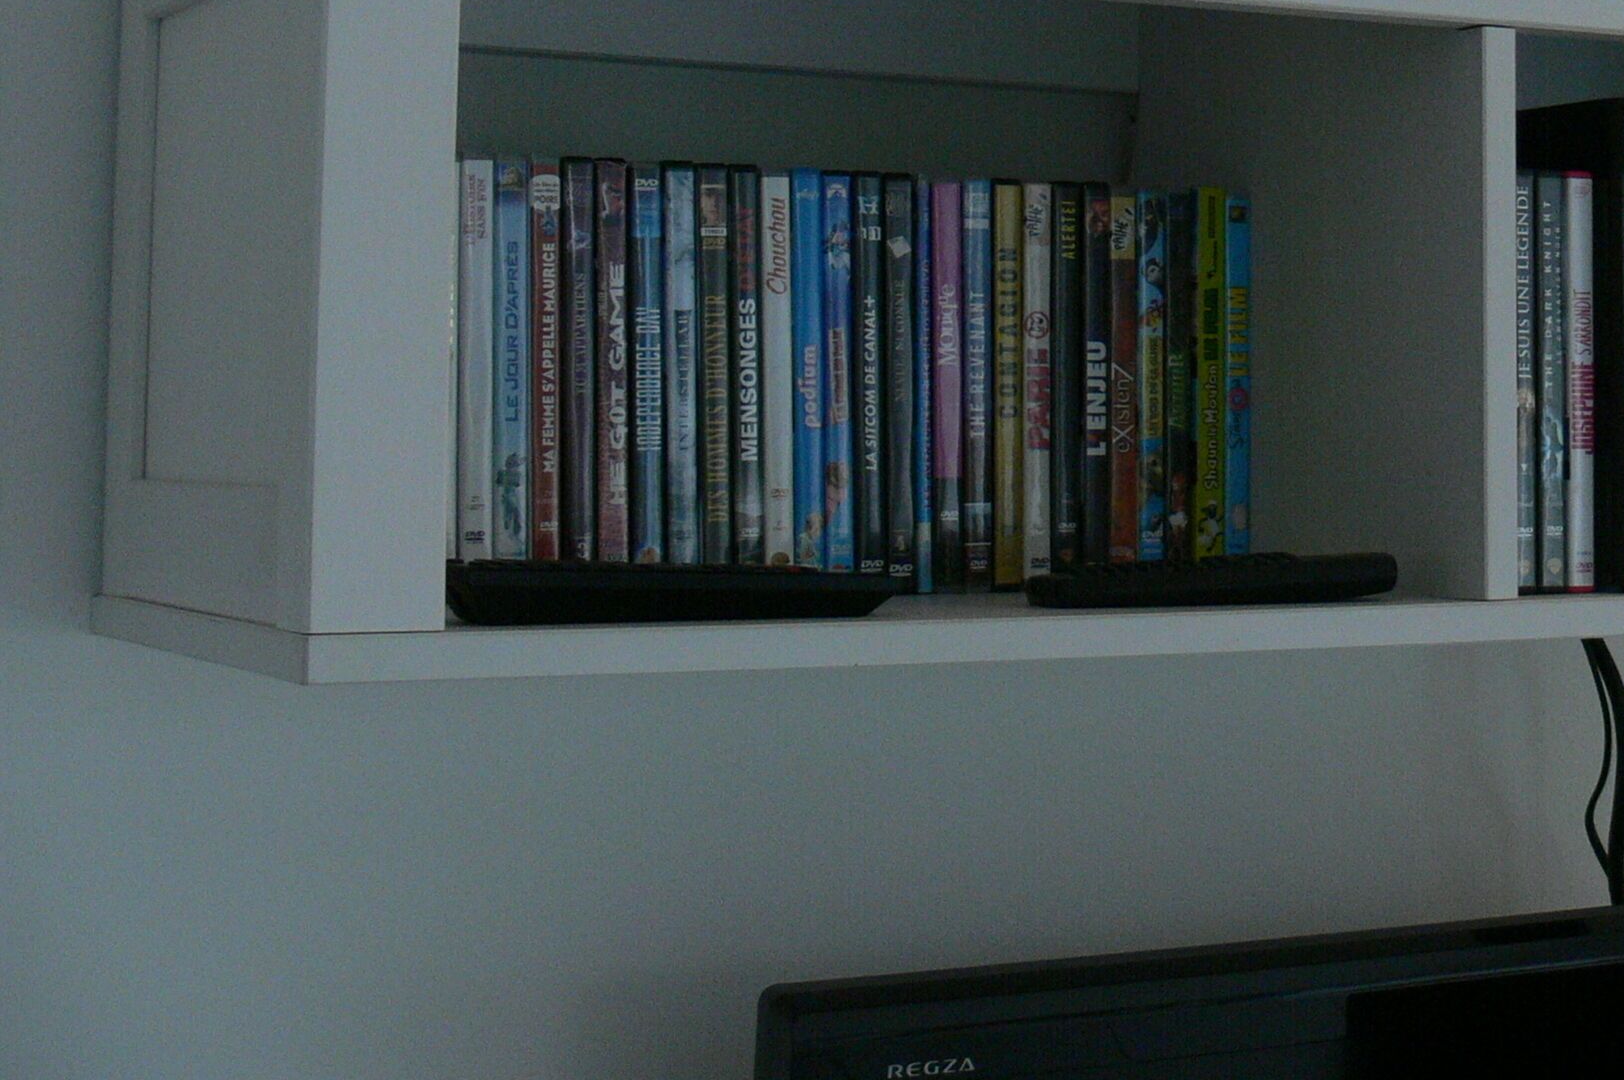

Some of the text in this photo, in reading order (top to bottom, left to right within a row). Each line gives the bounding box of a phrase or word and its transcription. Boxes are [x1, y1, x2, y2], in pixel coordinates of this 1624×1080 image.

[634, 178, 659, 187] DVD
[702, 237, 726, 246] DVD
[766, 196, 788, 296] Chouchou
[1059, 200, 1076, 261] ALERTE!
[1228, 286, 1249, 345] FILM
[1517, 185, 1532, 379] JE SUIS UNE LEGENDE
[1543, 200, 1553, 388] THE DARK KNIGHT
[1572, 288, 1592, 356] S'ARRONDIT
[503, 240, 519, 423] LE JOUR D'APRÈS
[542, 242, 556, 473] MA FEMME S'APPELLE MAURICE
[938, 283, 958, 367] Monique
[969, 289, 985, 438] THE REVENANT
[998, 247, 1018, 418] CONTAGION
[608, 260, 627, 505] HE GOT GAME
[635, 306, 661, 451] INDEPENDENCE DAY
[704, 295, 729, 522] DES HOMMES D'HONNEUR
[739, 298, 757, 462] MENSONGES
[798, 343, 822, 428] podium
[863, 294, 878, 471] LA SITCOM DE CANAL+
[1200, 365, 1218, 424] Mouton
[1202, 439, 1218, 490] Shaun
[861, 559, 884, 568] DVD
[889, 563, 913, 572] DVD
[970, 559, 988, 567] DVD
[887, 1057, 976, 1080] REGZA
